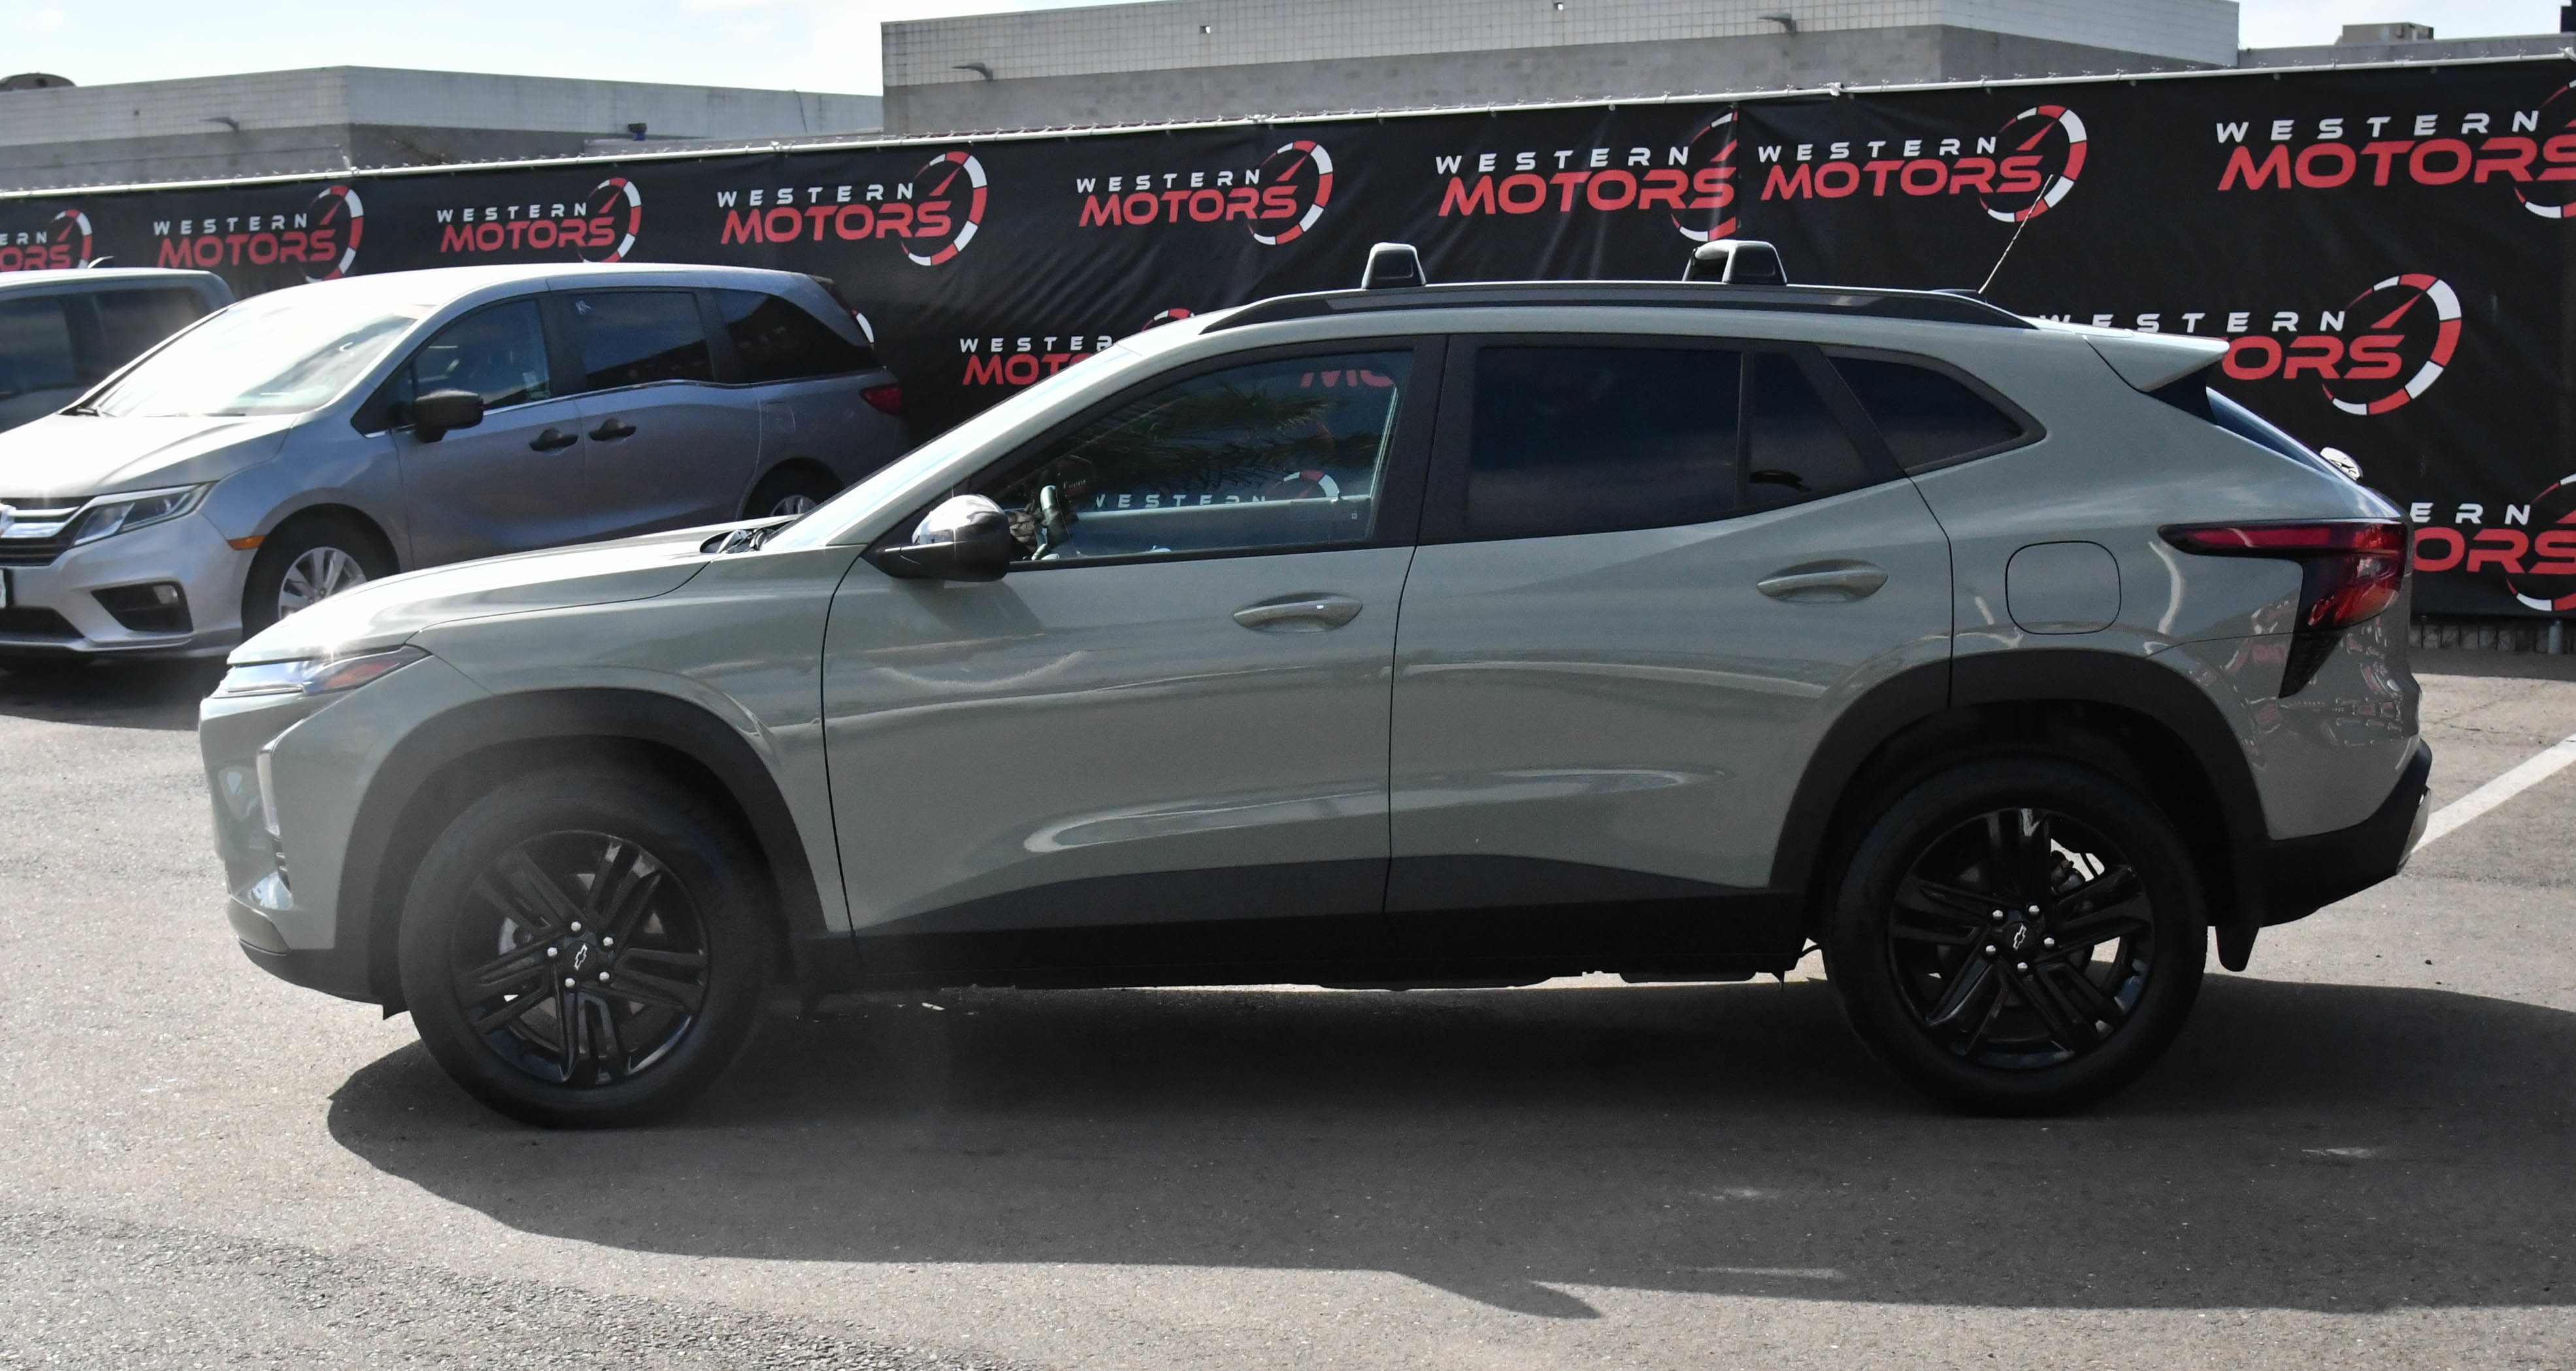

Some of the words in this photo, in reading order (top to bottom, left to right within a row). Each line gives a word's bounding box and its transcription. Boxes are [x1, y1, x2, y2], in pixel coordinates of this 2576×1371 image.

[2216, 110, 2539, 143] WESTERN
[1436, 146, 1689, 174] WESTERN
[1758, 137, 1996, 163] WESTERN
[2217, 133, 2576, 190] MOTORS
[717, 182, 913, 208] WESTERN
[1076, 169, 1260, 193] WESTERN
[1438, 167, 1737, 216] MOTORS
[1760, 155, 2043, 201] MOTORS
[437, 202, 587, 223] WESTERN
[720, 200, 951, 244] MOTORS
[1078, 185, 1298, 227] MOTORS
[153, 213, 307, 236] WESTERN
[440, 216, 616, 253] MOTORS
[157, 229, 337, 268] MOTORS
[962, 352, 1093, 386] MOT
[2218, 335, 2405, 380] ORS
